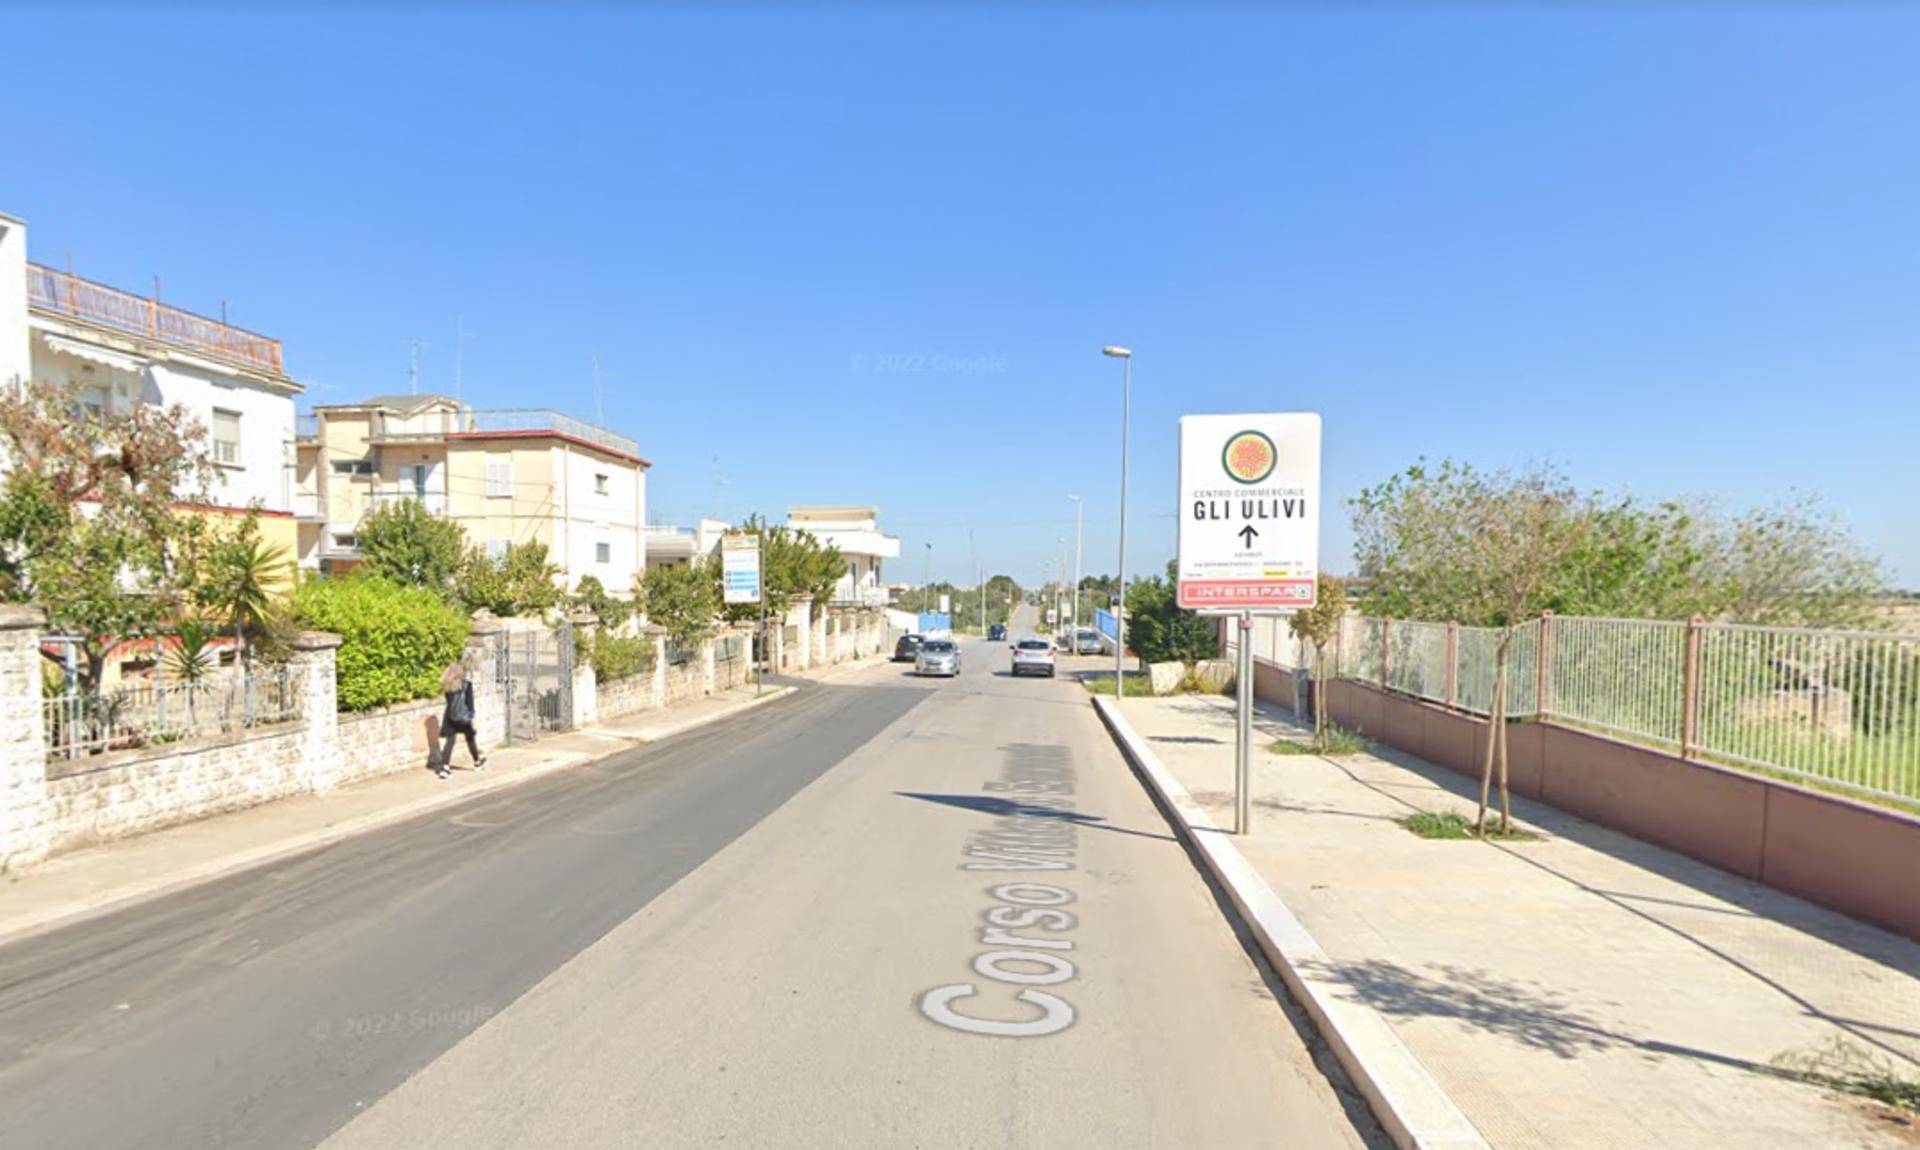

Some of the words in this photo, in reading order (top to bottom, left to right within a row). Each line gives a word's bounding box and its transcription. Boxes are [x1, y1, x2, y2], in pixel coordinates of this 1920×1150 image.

[1193, 489, 1232, 498] CENTRO
[1234, 488, 1305, 498] COMMERCIALE
[1193, 500, 1230, 521] GLI
[1241, 499, 1305, 520] ULIVI
[1196, 586, 1296, 598] INTERSPAR
